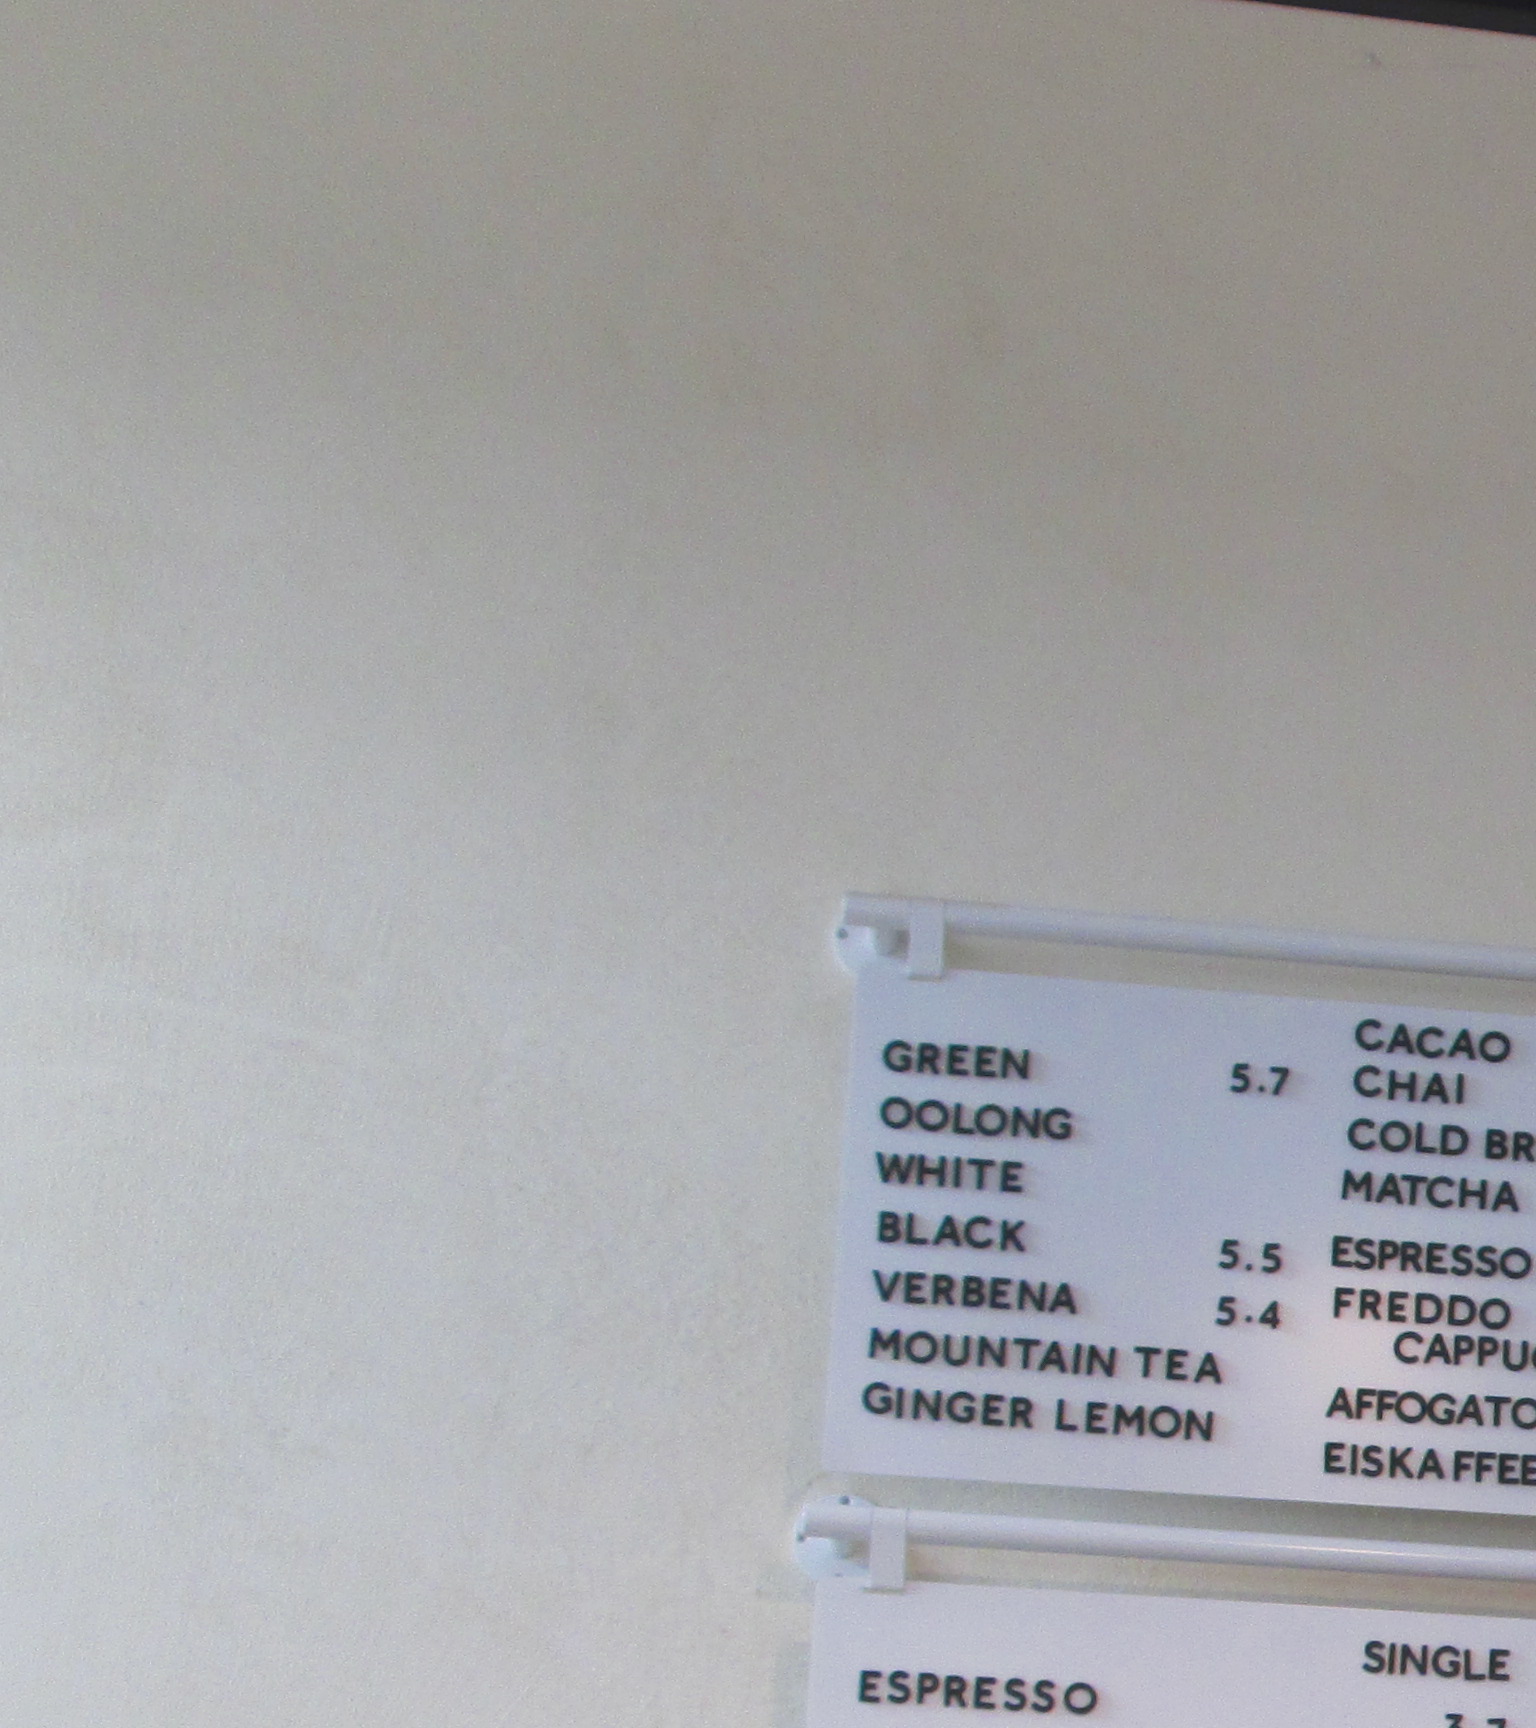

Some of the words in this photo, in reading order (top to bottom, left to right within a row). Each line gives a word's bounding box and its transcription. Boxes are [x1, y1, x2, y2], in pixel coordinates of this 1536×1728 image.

[882, 1039, 1031, 1080] GREEN
[1354, 1018, 1512, 1064] CACAO
[1230, 1063, 1290, 1096] 5.7
[1353, 1064, 1465, 1105] CHAI
[879, 1096, 1073, 1141] OOLONG
[1347, 1117, 1470, 1157] COLD
[875, 1151, 1024, 1194] WHITE
[1341, 1169, 1520, 1213] MATCHA
[877, 1210, 1026, 1253] BLACK
[1218, 1239, 1283, 1275] 5.5
[1330, 1235, 1533, 1280] ESPRESSO
[872, 1270, 1078, 1315] VERBENA
[1215, 1295, 1282, 1330] 5.4
[1333, 1286, 1512, 1331] FREDDO
[868, 1327, 1117, 1378] MOUNTAIN
[1133, 1346, 1223, 1385] TEA
[862, 1381, 1034, 1430] GINGER
[1054, 1398, 1215, 1442] LEMON
[1362, 1640, 1511, 1682] SINGLE
[858, 1669, 1099, 1716] ESPRESSO
